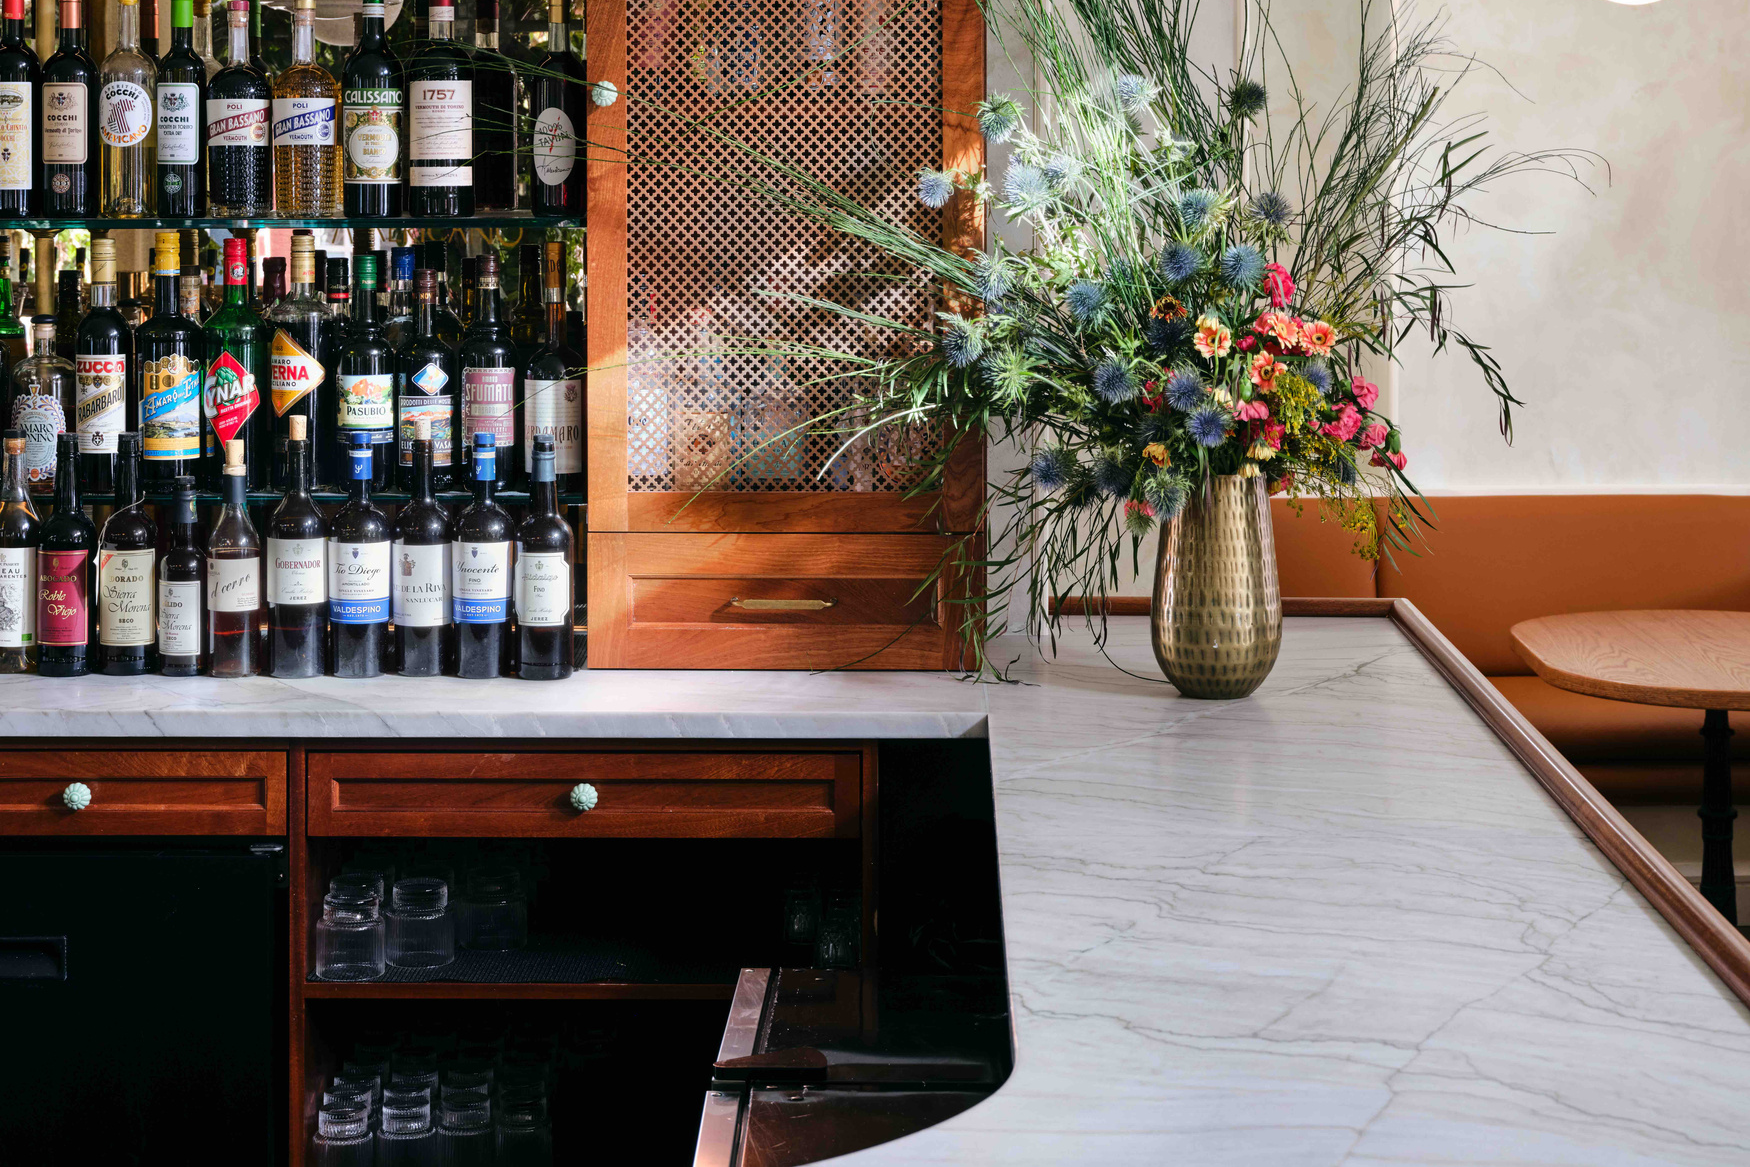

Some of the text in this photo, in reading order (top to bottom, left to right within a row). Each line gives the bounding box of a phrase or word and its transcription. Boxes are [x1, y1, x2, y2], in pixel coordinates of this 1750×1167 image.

[104, 84, 142, 94] APERITIVO
[106, 89, 139, 100] COCCHI
[423, 89, 455, 100] 1757
[345, 90, 402, 103] CALISSANO
[210, 110, 265, 136] GRAN BASSANO
[275, 109, 330, 135] GRAN BASSANO
[101, 125, 147, 143] AMERICANO
[204, 374, 255, 419] CYNAR
[466, 384, 513, 401] SFUMATO
[78, 386, 122, 423] RABARBARO
[347, 406, 386, 416] PASUBIO
[20, 424, 53, 432] AMARO
[275, 557, 321, 569] GOBERNADOR
[348, 564, 381, 580] Diego
[221, 574, 250, 594] cerro
[426, 582, 446, 593] RIVA
[39, 589, 66, 601] Roble
[103, 585, 137, 599] Sierra
[48, 604, 77, 619] Viejo
[108, 600, 151, 613] Morena
[333, 605, 381, 614] VALDESPINO
[455, 605, 501, 613] VALDESPINO
[162, 620, 192, 631] Morena
